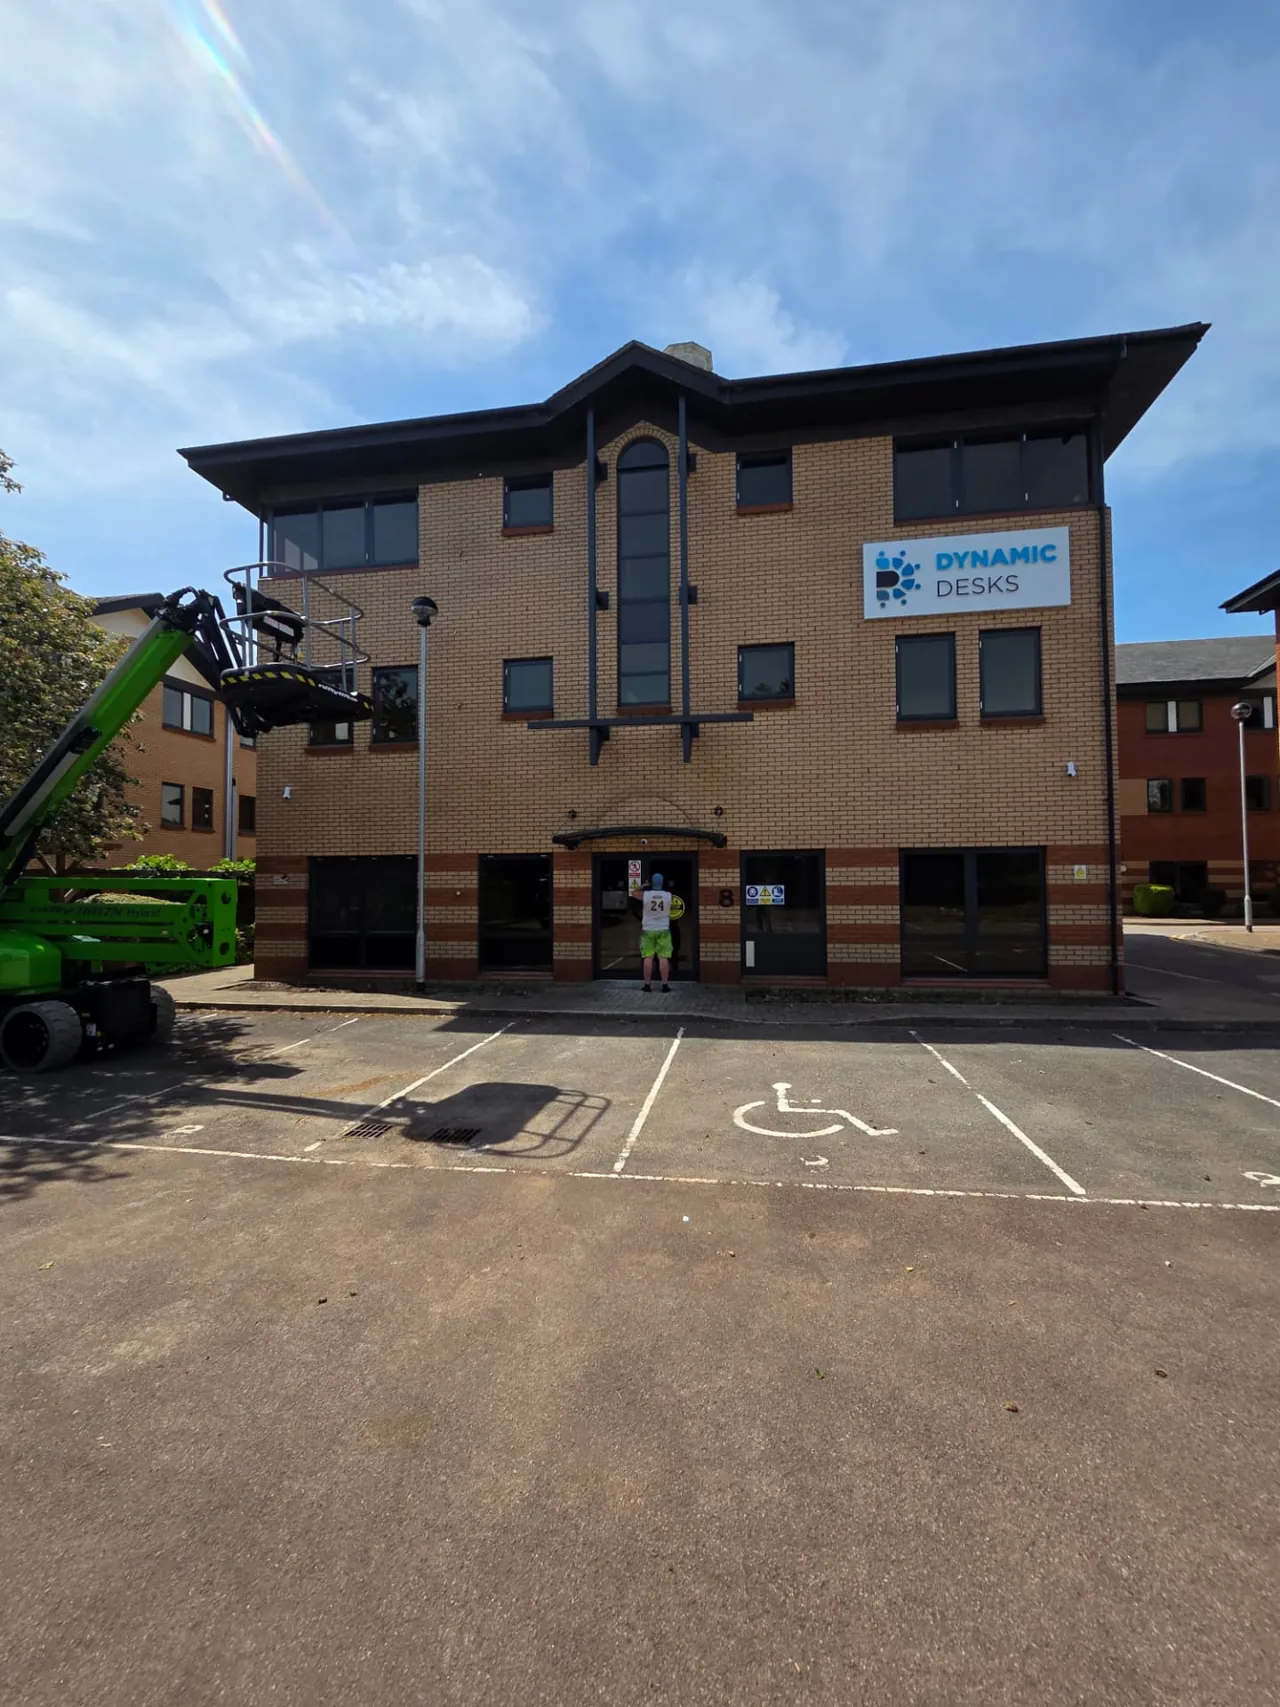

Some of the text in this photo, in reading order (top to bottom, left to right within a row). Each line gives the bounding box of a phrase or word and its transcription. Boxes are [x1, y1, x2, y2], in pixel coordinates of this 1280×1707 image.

[936, 544, 1057, 571] DYNAMIC
[937, 575, 1019, 597] DESKS
[651, 900, 664, 912] 24
[719, 889, 733, 907] 8
